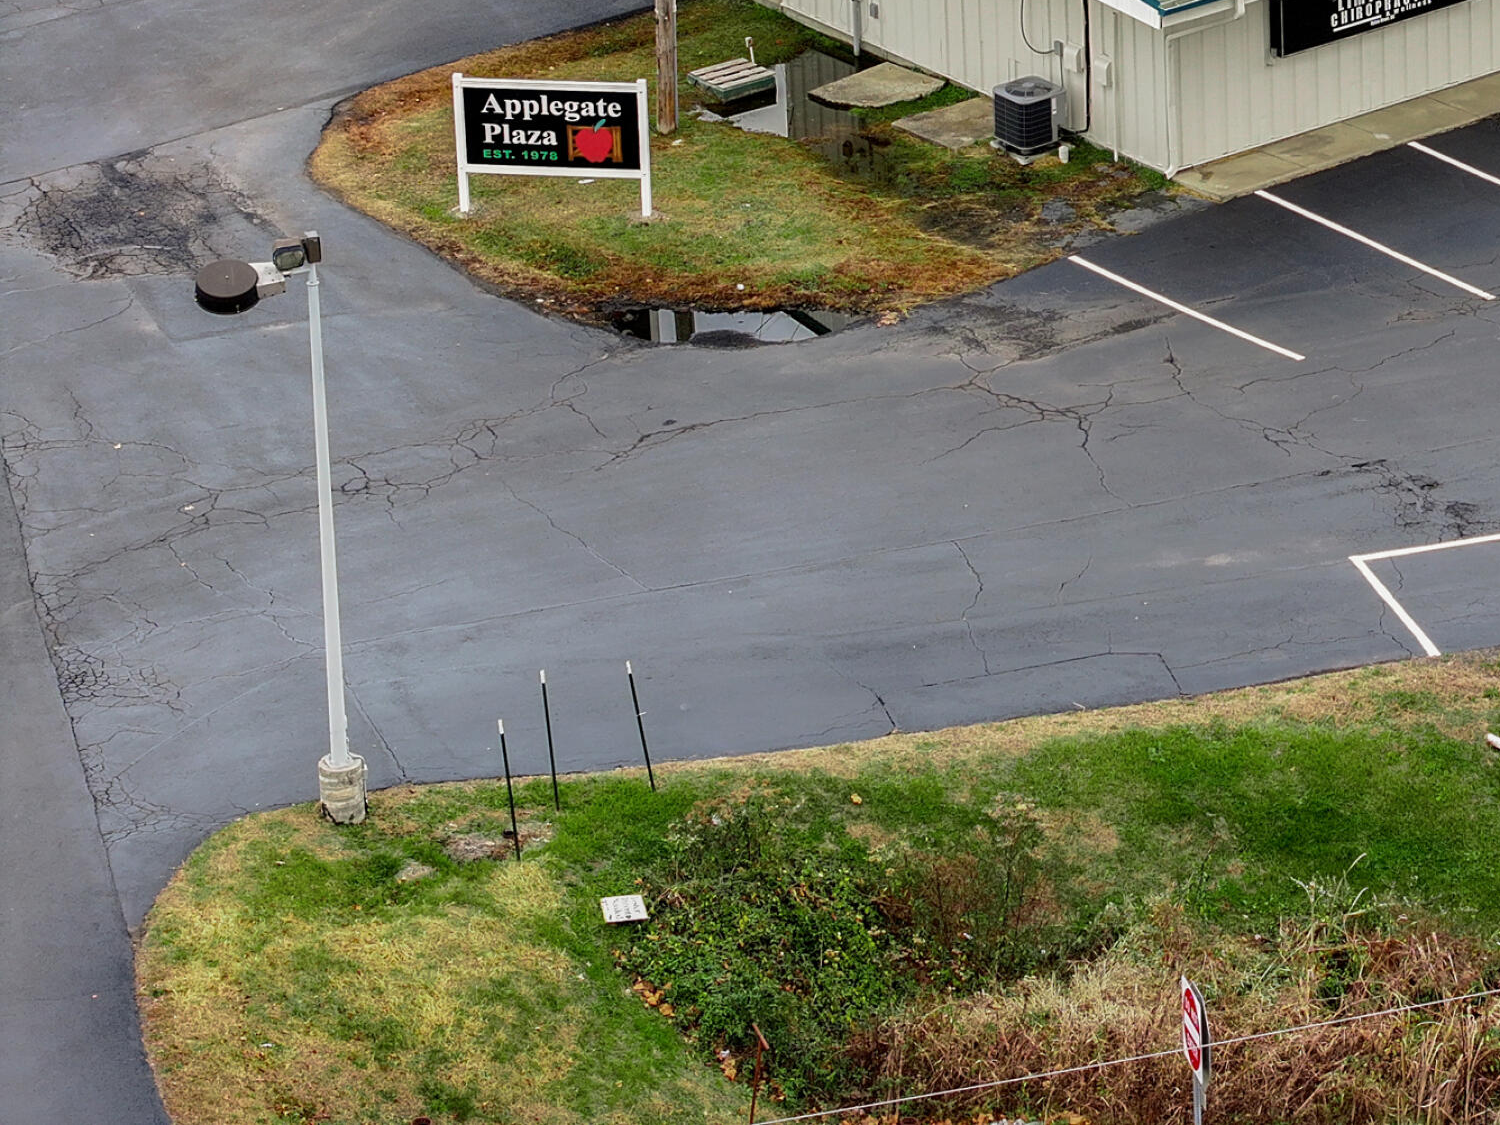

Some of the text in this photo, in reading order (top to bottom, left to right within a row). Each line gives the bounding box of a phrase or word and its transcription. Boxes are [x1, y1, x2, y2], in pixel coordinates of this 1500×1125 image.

[480, 92, 622, 122] Applegate
[482, 122, 558, 146] Plaza
[483, 149, 558, 161] EST. 1978
